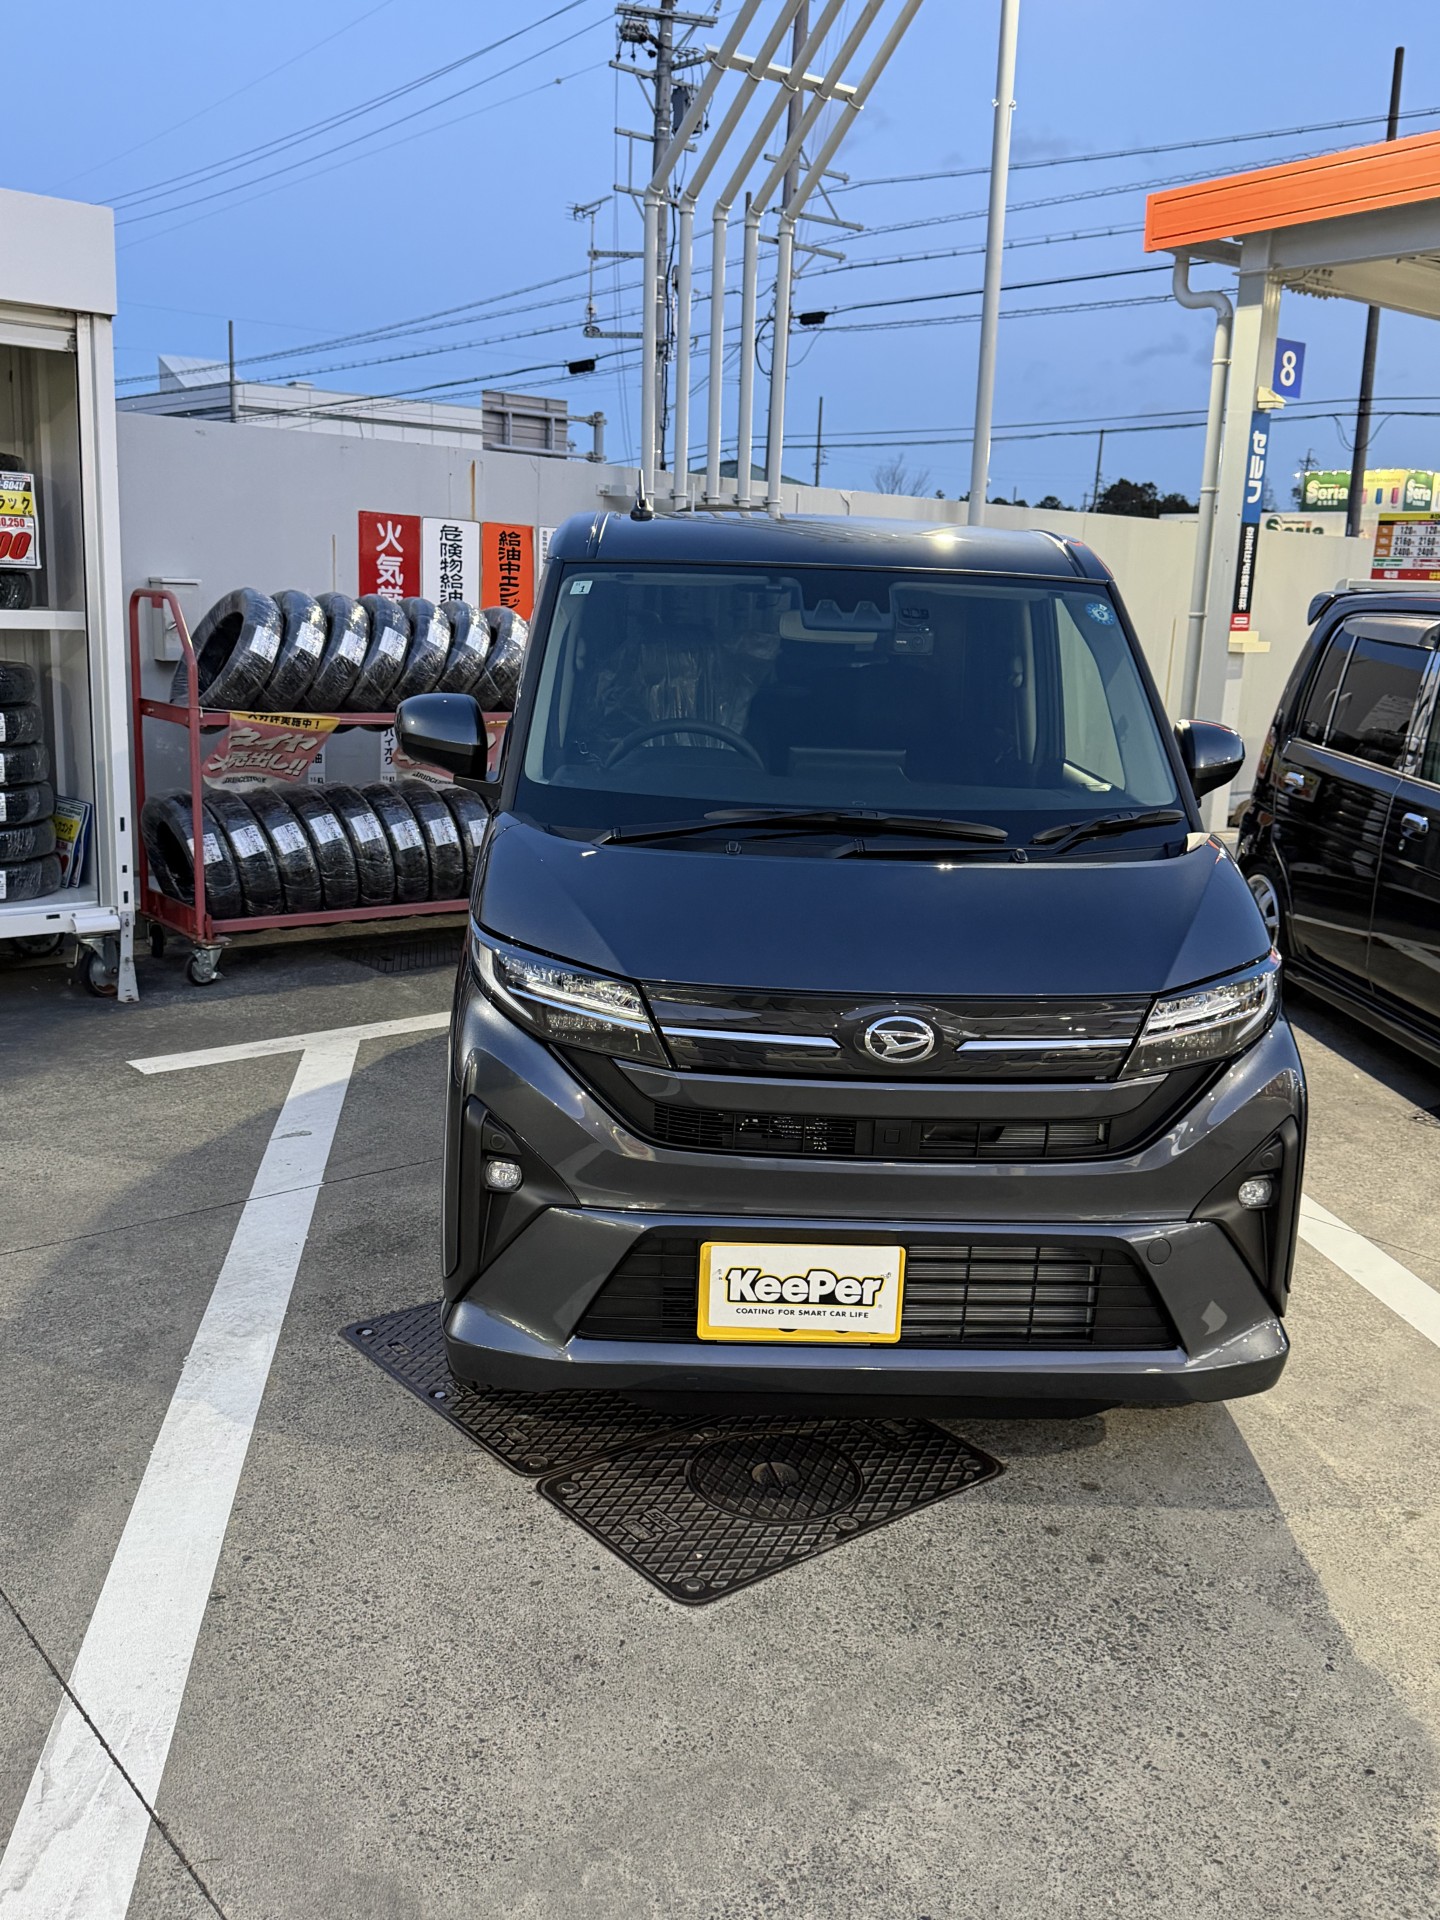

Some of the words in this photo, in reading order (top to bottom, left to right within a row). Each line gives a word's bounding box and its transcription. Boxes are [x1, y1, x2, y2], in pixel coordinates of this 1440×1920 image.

[1280, 350, 1297, 387] 8
[1246, 430, 1267, 504] セルフ
[1305, 479, 1349, 503] Seria
[439, 524, 463, 603] 危険物給油
[498, 530, 522, 608] 給油中エンジ
[727, 1268, 883, 1306] KeePer
[736, 1307, 775, 1316] COATING
[778, 1308, 795, 1316] FOR
[798, 1309, 826, 1317] SMART
[829, 1310, 847, 1318] CAR
[849, 1311, 869, 1319] LIFE
